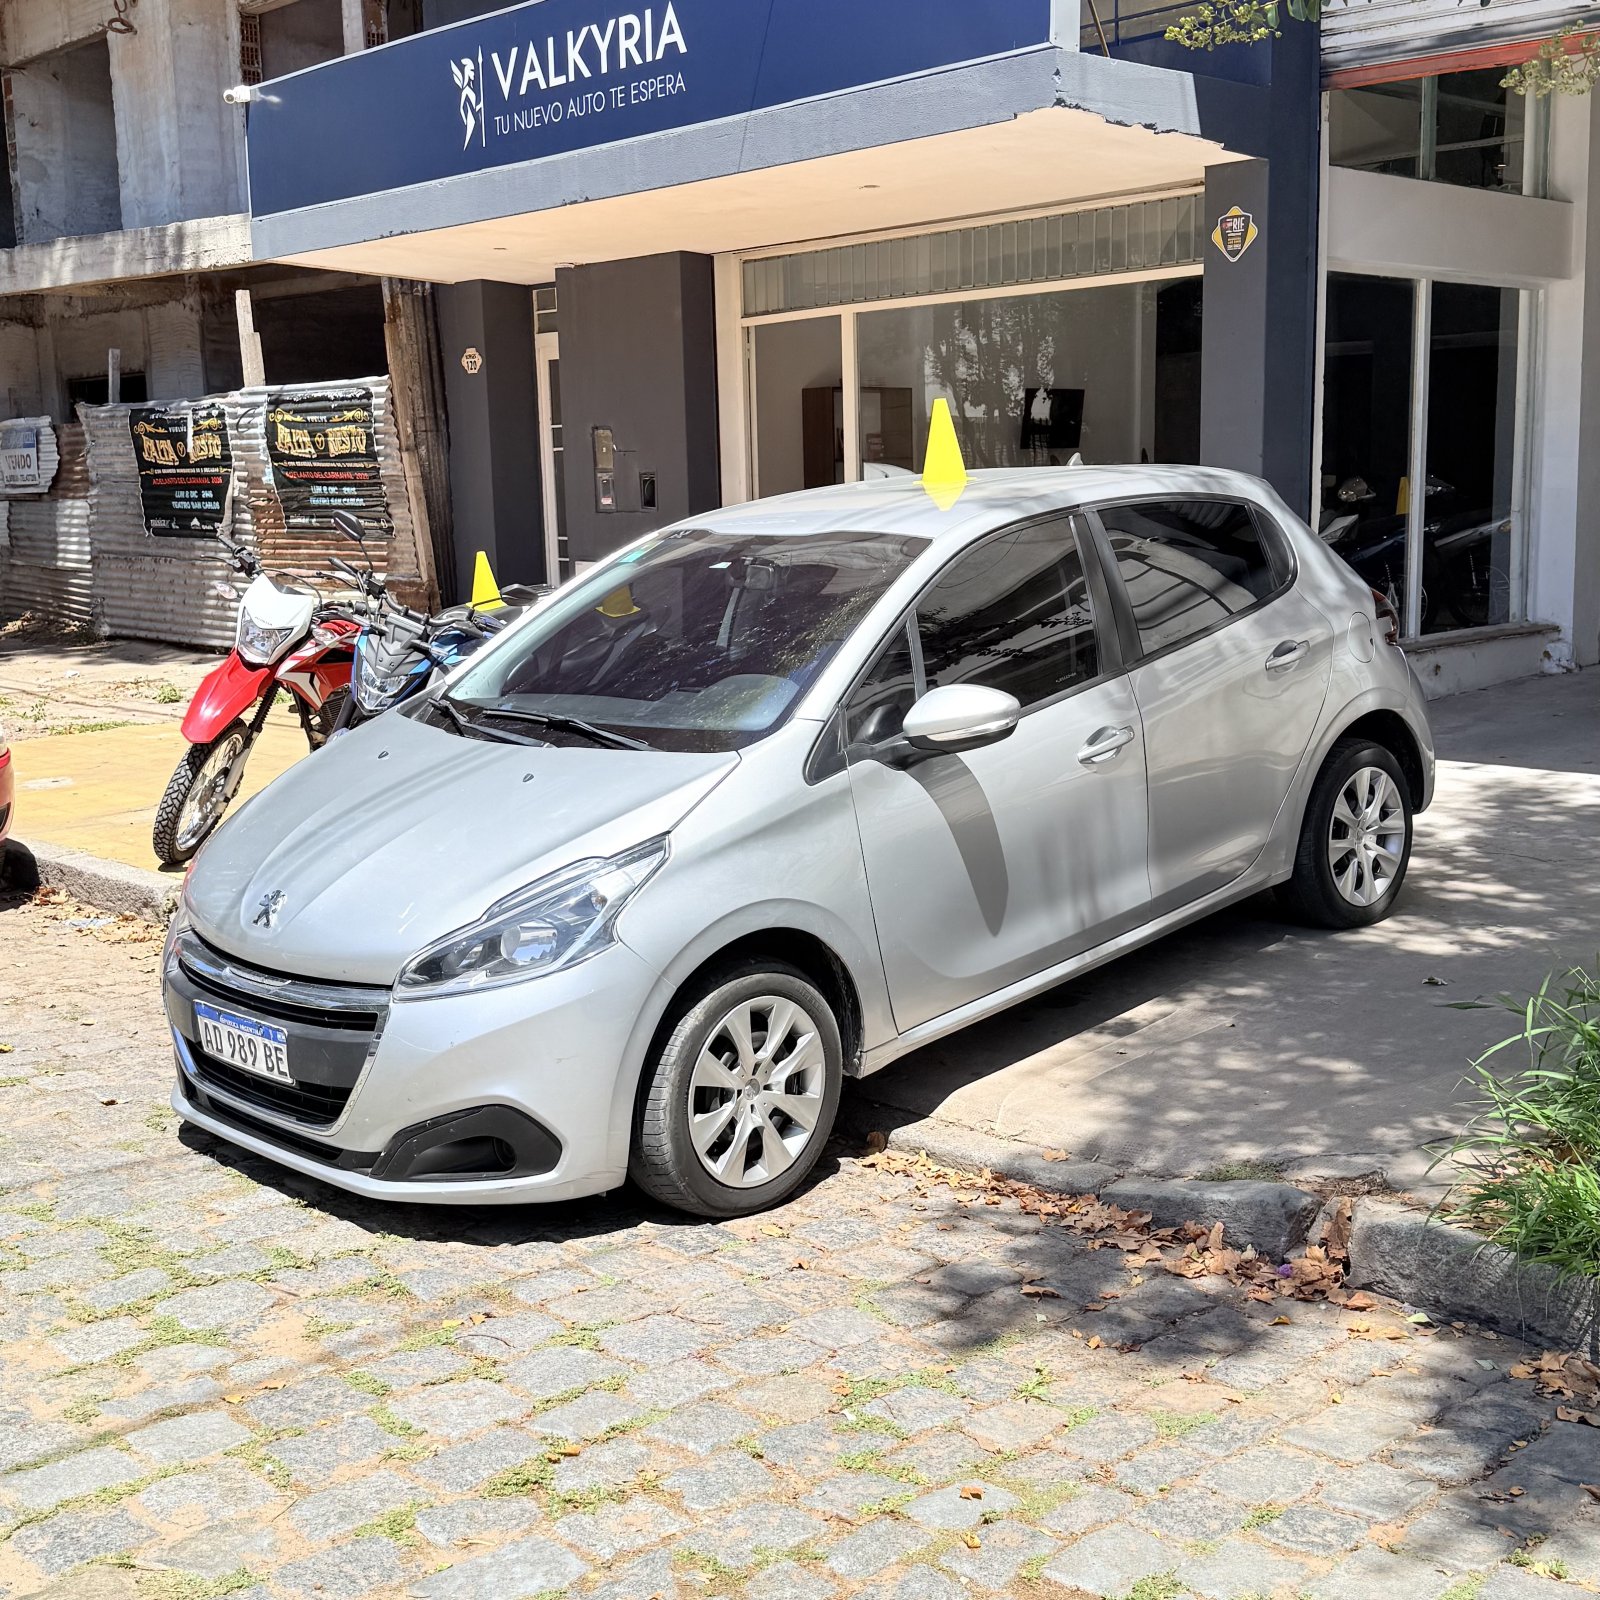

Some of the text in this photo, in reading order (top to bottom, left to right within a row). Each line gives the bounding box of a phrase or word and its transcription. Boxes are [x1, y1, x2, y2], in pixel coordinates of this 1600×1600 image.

[491, 1, 687, 101] VALKYRIA
[494, 72, 686, 135] TU NUEVO AUTO TE ESPERA
[5, 454, 31, 470] VENDO
[203, 1021, 288, 1077] AD 989 BE
